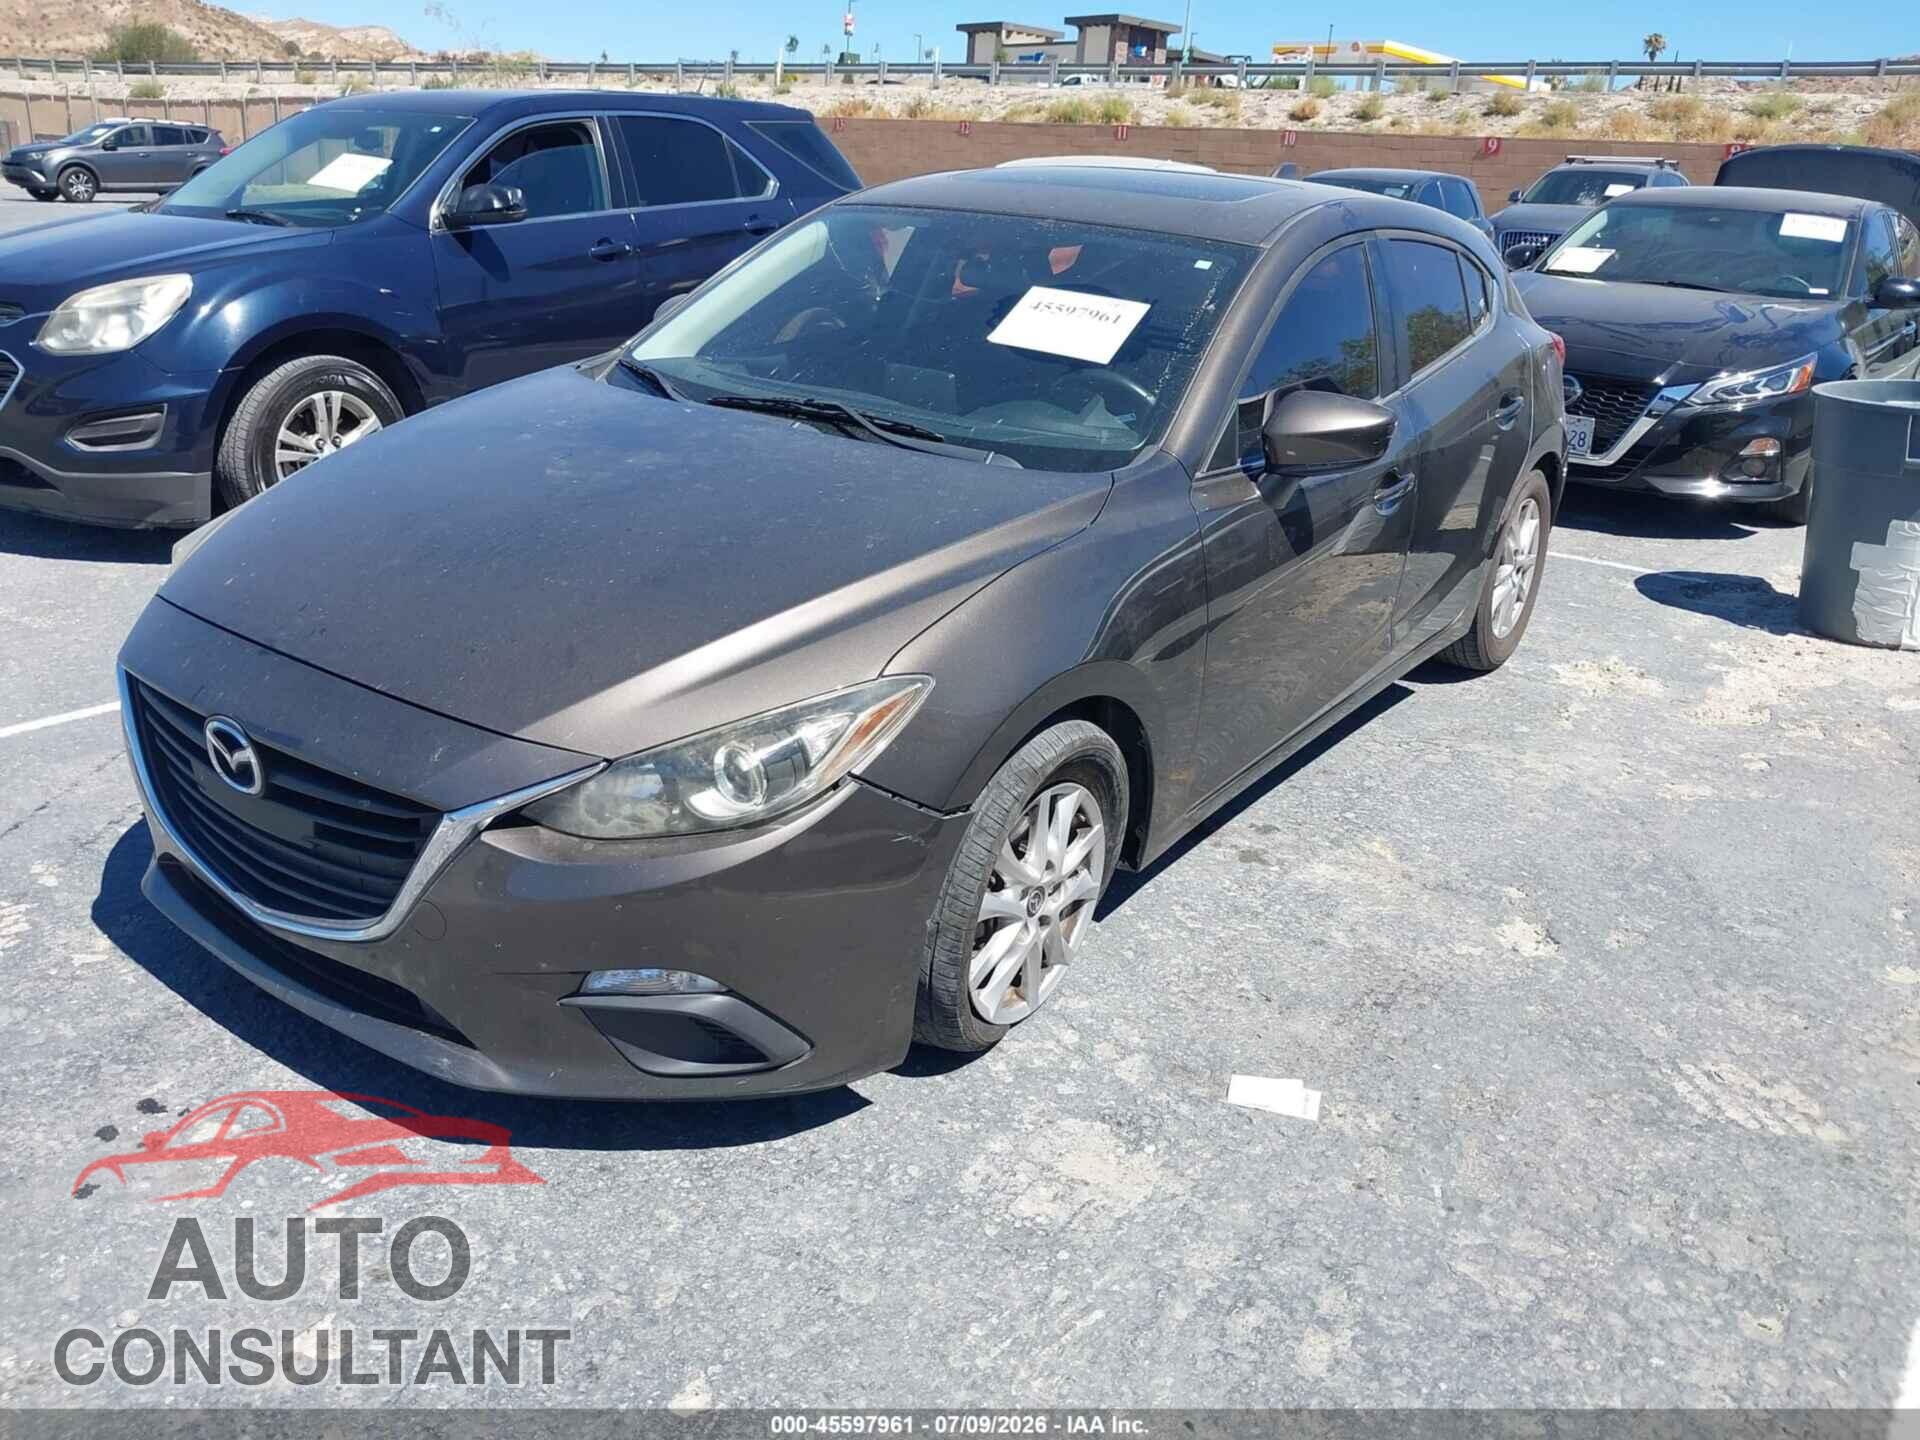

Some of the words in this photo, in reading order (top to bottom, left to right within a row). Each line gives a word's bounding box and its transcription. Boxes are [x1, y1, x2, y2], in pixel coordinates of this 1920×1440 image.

[1284, 131, 1297, 145] 10
[1488, 138, 1498, 154] 9
[1028, 300, 1122, 326] 45597961
